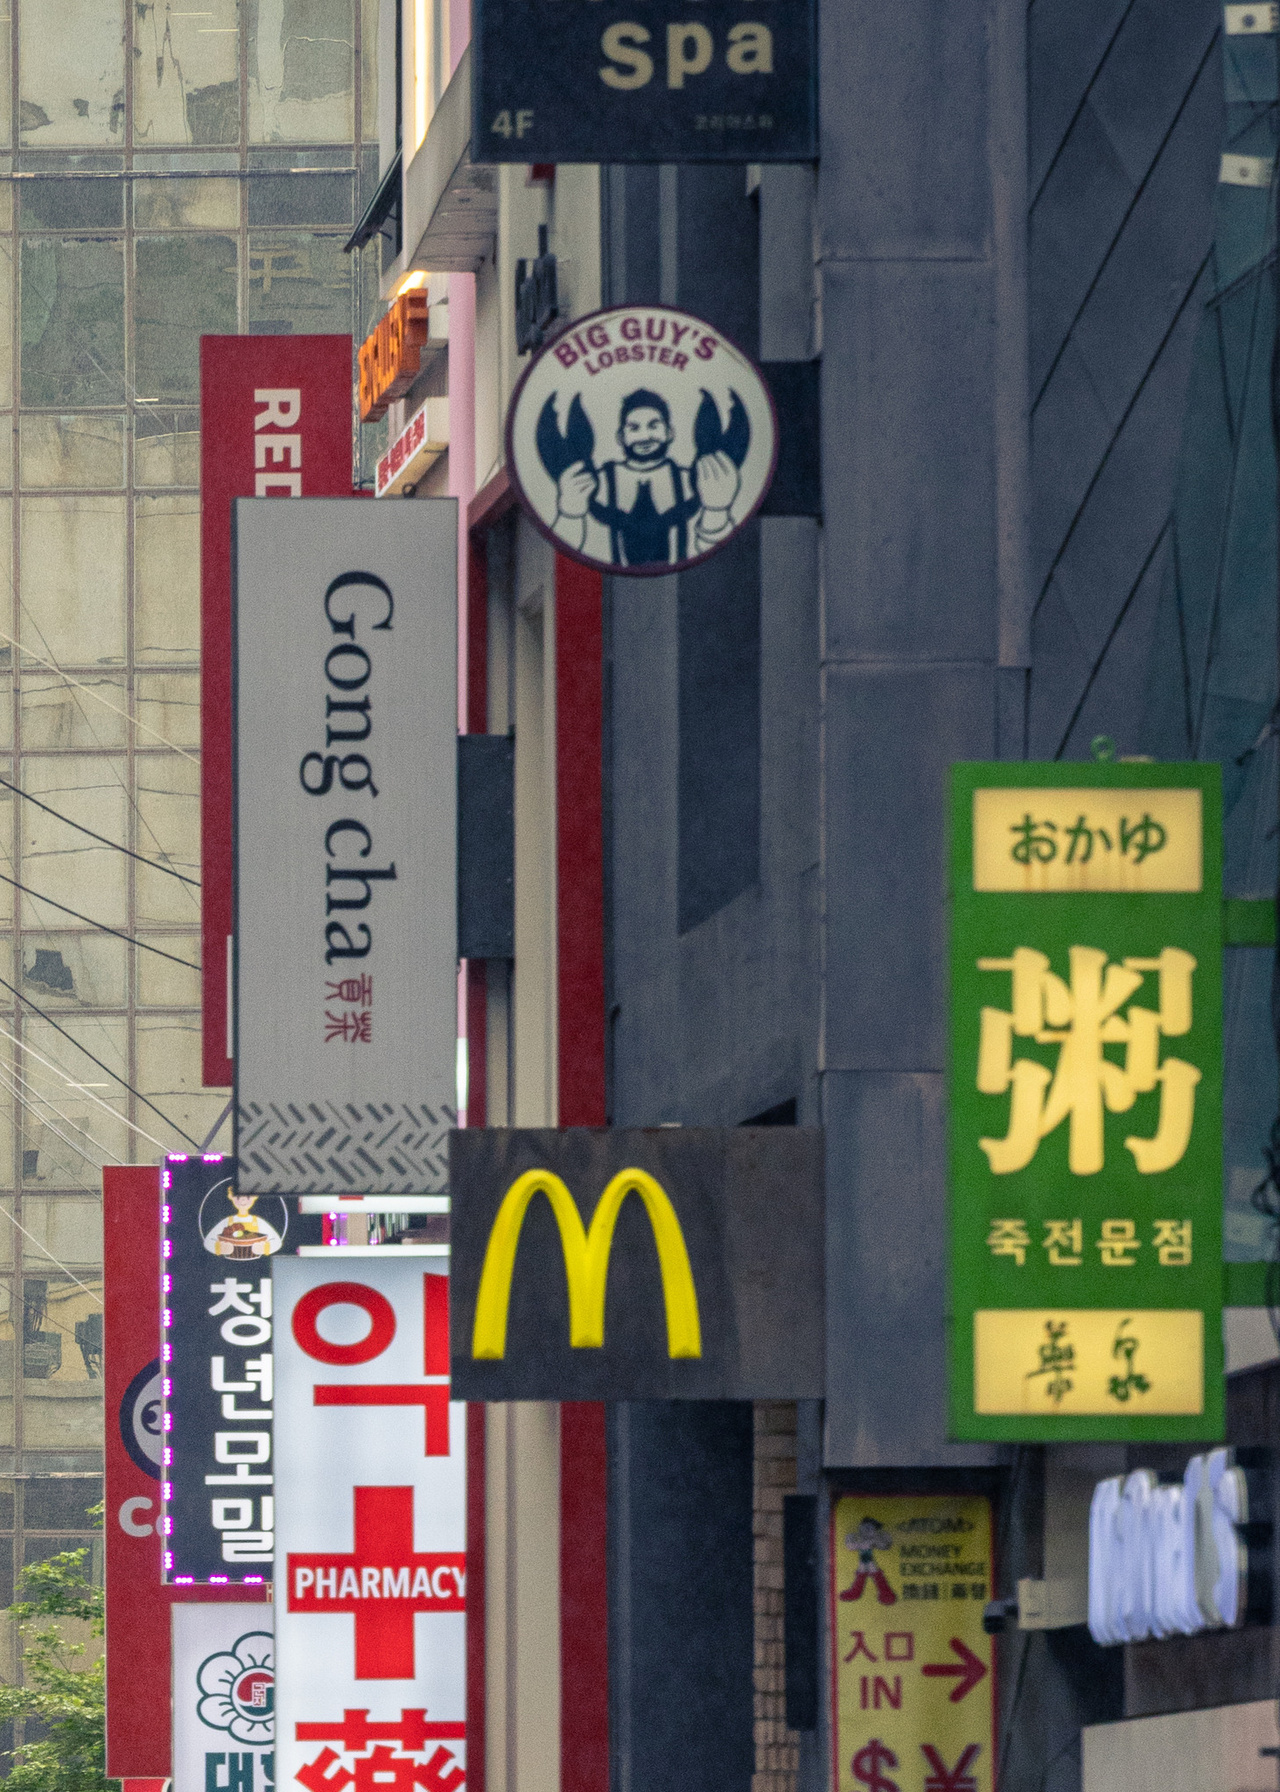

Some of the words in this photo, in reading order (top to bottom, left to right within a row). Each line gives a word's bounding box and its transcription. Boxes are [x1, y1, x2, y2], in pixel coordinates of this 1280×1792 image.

[491, 110, 535, 139] 4F
[552, 318, 610, 371] BIG
[620, 317, 722, 362] GUY'S
[583, 344, 689, 378] LOBSTER
[300, 570, 395, 798] Gong
[1009, 813, 1168, 866] おかゆ
[324, 818, 397, 965] cha
[977, 945, 1202, 1176] 粥
[986, 1218, 1194, 1266] 죽전문점
[295, 1567, 466, 1599] PHARMACY
[843, 1631, 915, 1663] 入口
[860, 1677, 903, 1710] IN
